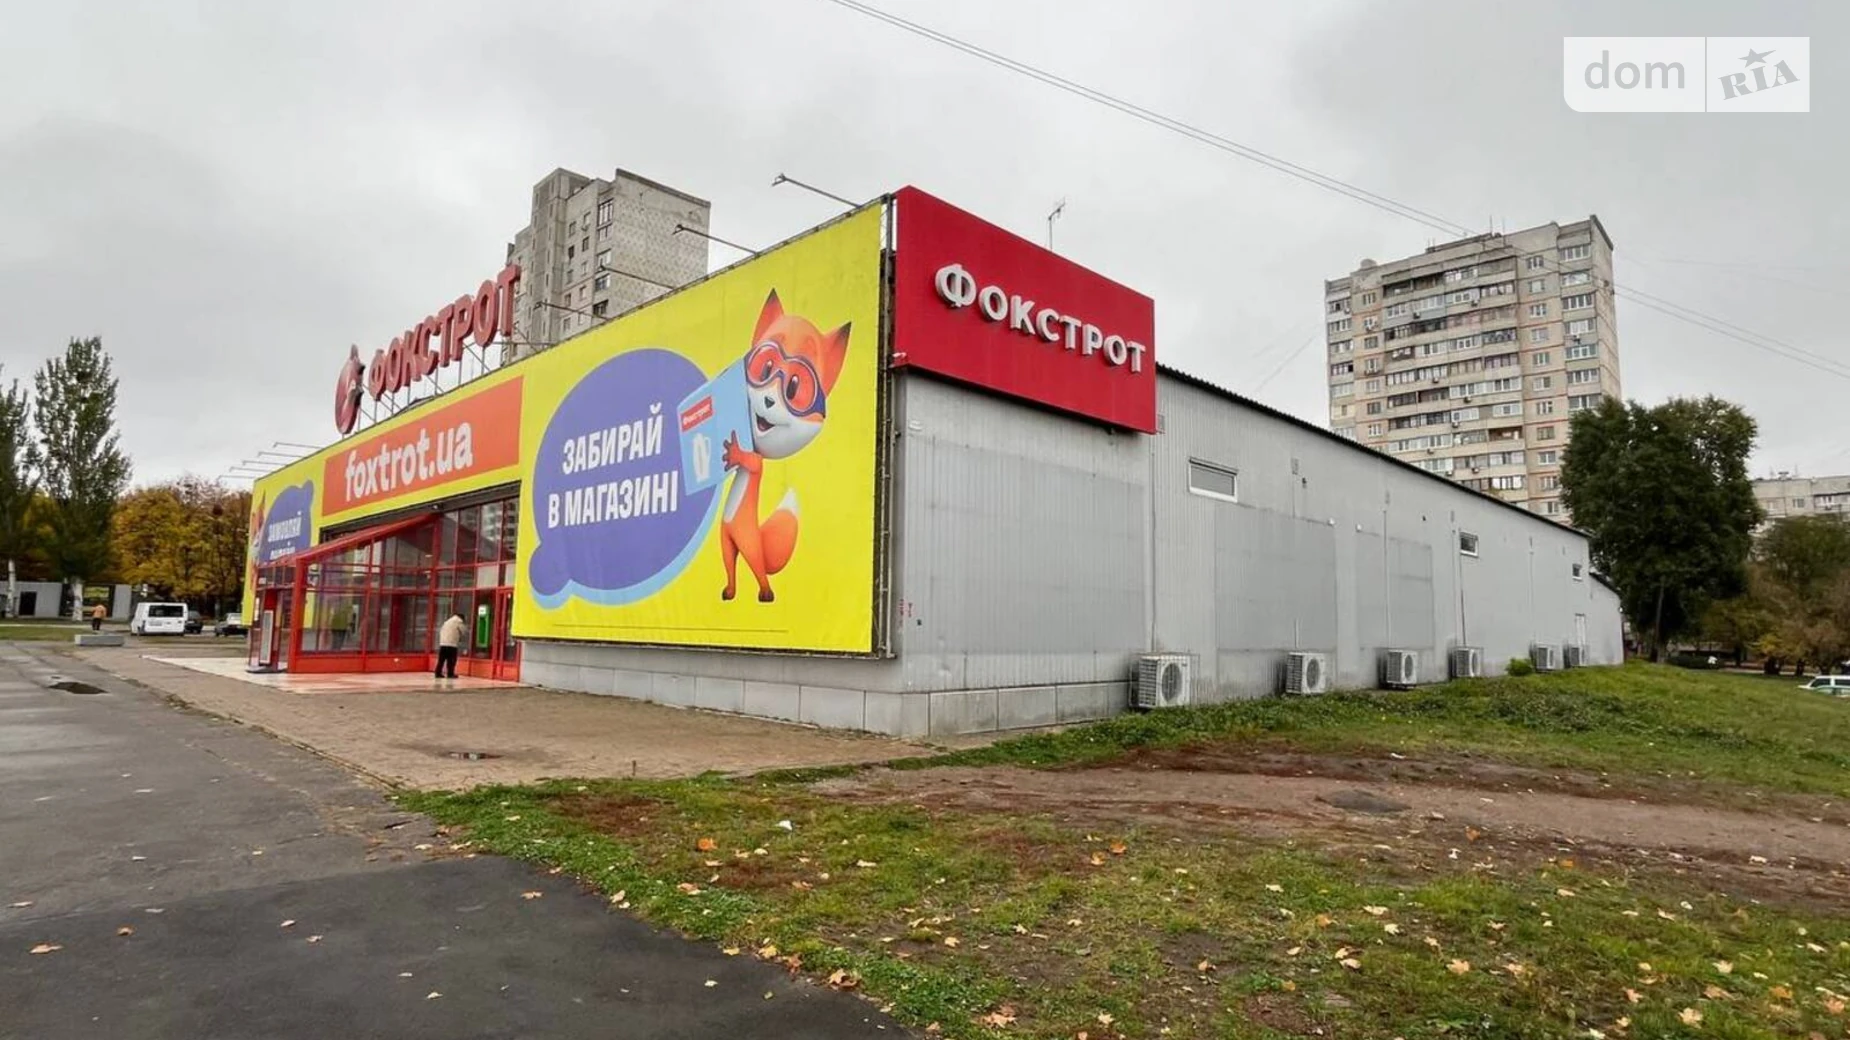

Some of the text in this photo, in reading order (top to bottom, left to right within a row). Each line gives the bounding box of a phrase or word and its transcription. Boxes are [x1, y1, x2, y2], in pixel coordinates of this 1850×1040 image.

[368, 264, 521, 401] ФОКСТРОТ
[935, 263, 1146, 373] ФОКСТРОТ
[345, 422, 473, 501] foxtrot.ua
[562, 402, 664, 475] ЗАБИРАЙ
[548, 470, 679, 528] В МАГАЗИНІ
